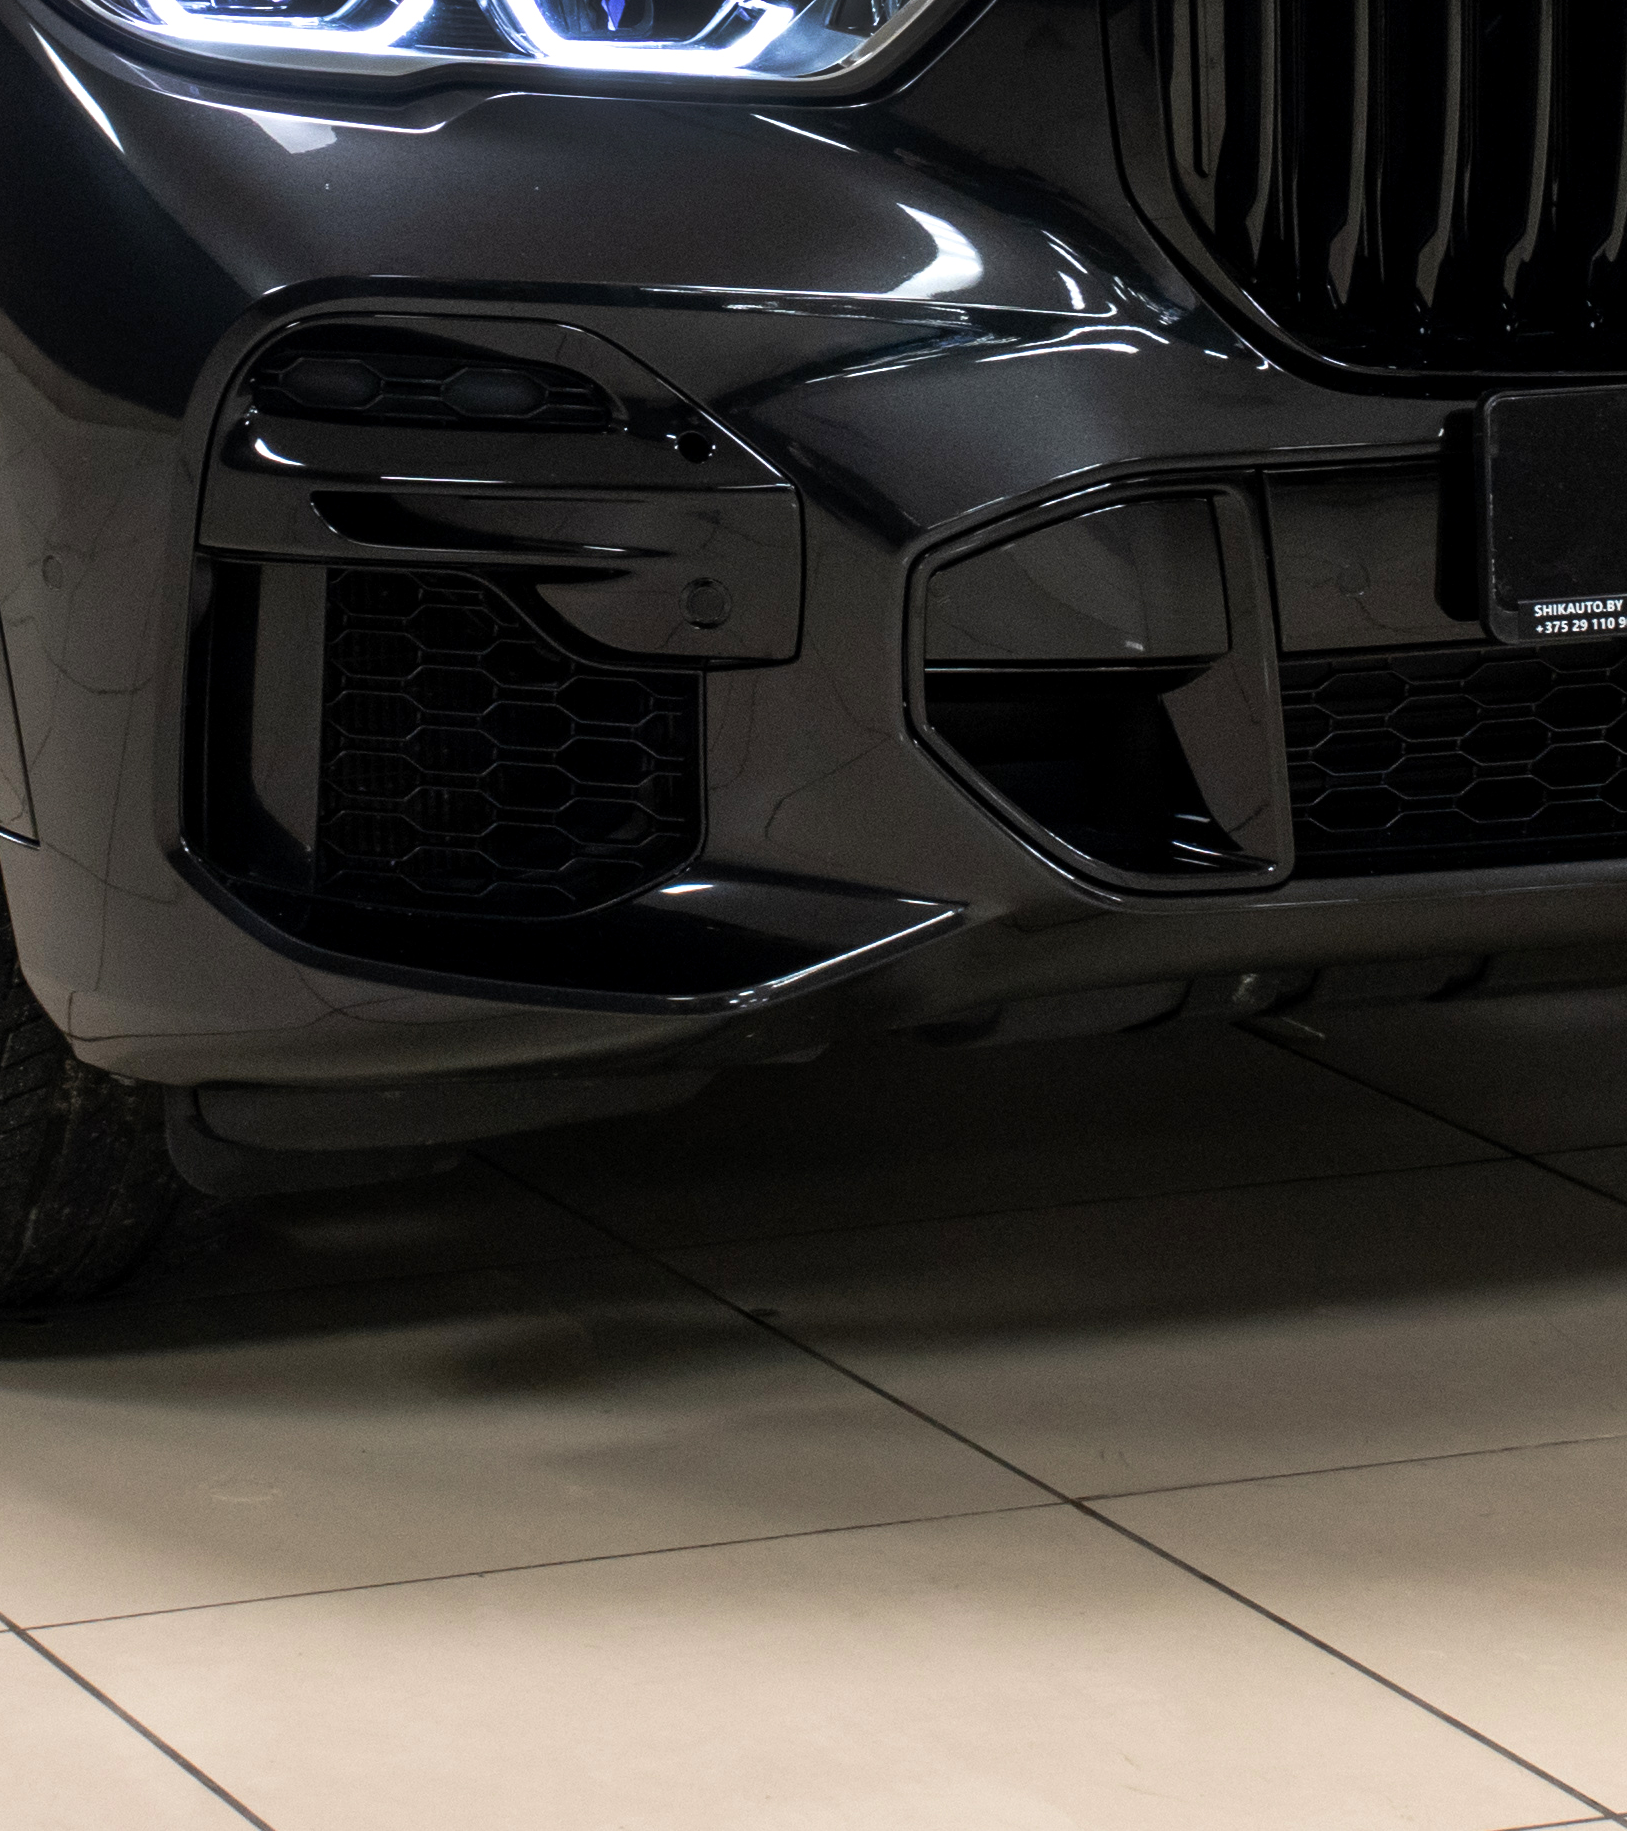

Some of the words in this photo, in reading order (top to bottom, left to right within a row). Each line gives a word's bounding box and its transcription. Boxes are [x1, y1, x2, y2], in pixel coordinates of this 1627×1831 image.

[1534, 599, 1624, 618] SHIKAUTO.BY
[1535, 620, 1569, 634] +375
[1571, 619, 1588, 632] 29
[1591, 616, 1616, 630] 110
